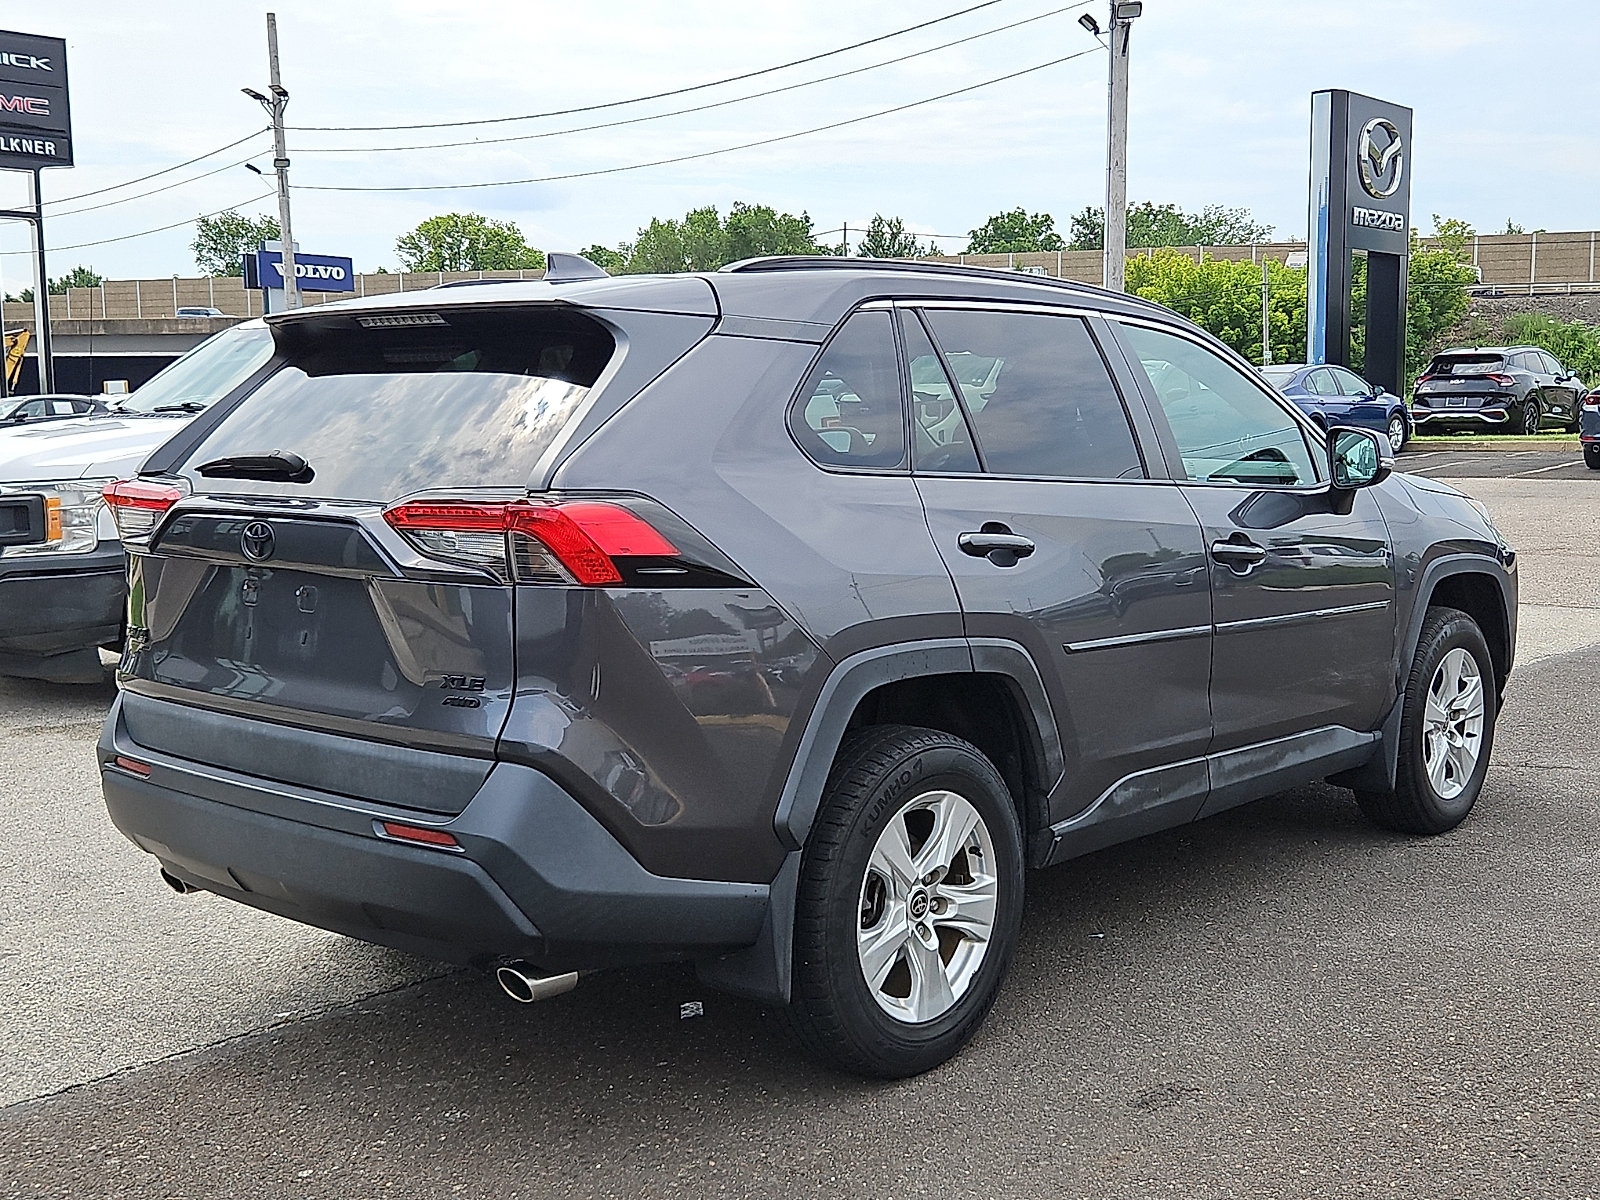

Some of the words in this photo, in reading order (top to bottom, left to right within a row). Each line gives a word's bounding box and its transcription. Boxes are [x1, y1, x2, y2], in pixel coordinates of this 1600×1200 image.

[0, 52, 54, 71] ICK
[439, 674, 486, 691] XLE
[861, 770, 912, 838] KUMHO
